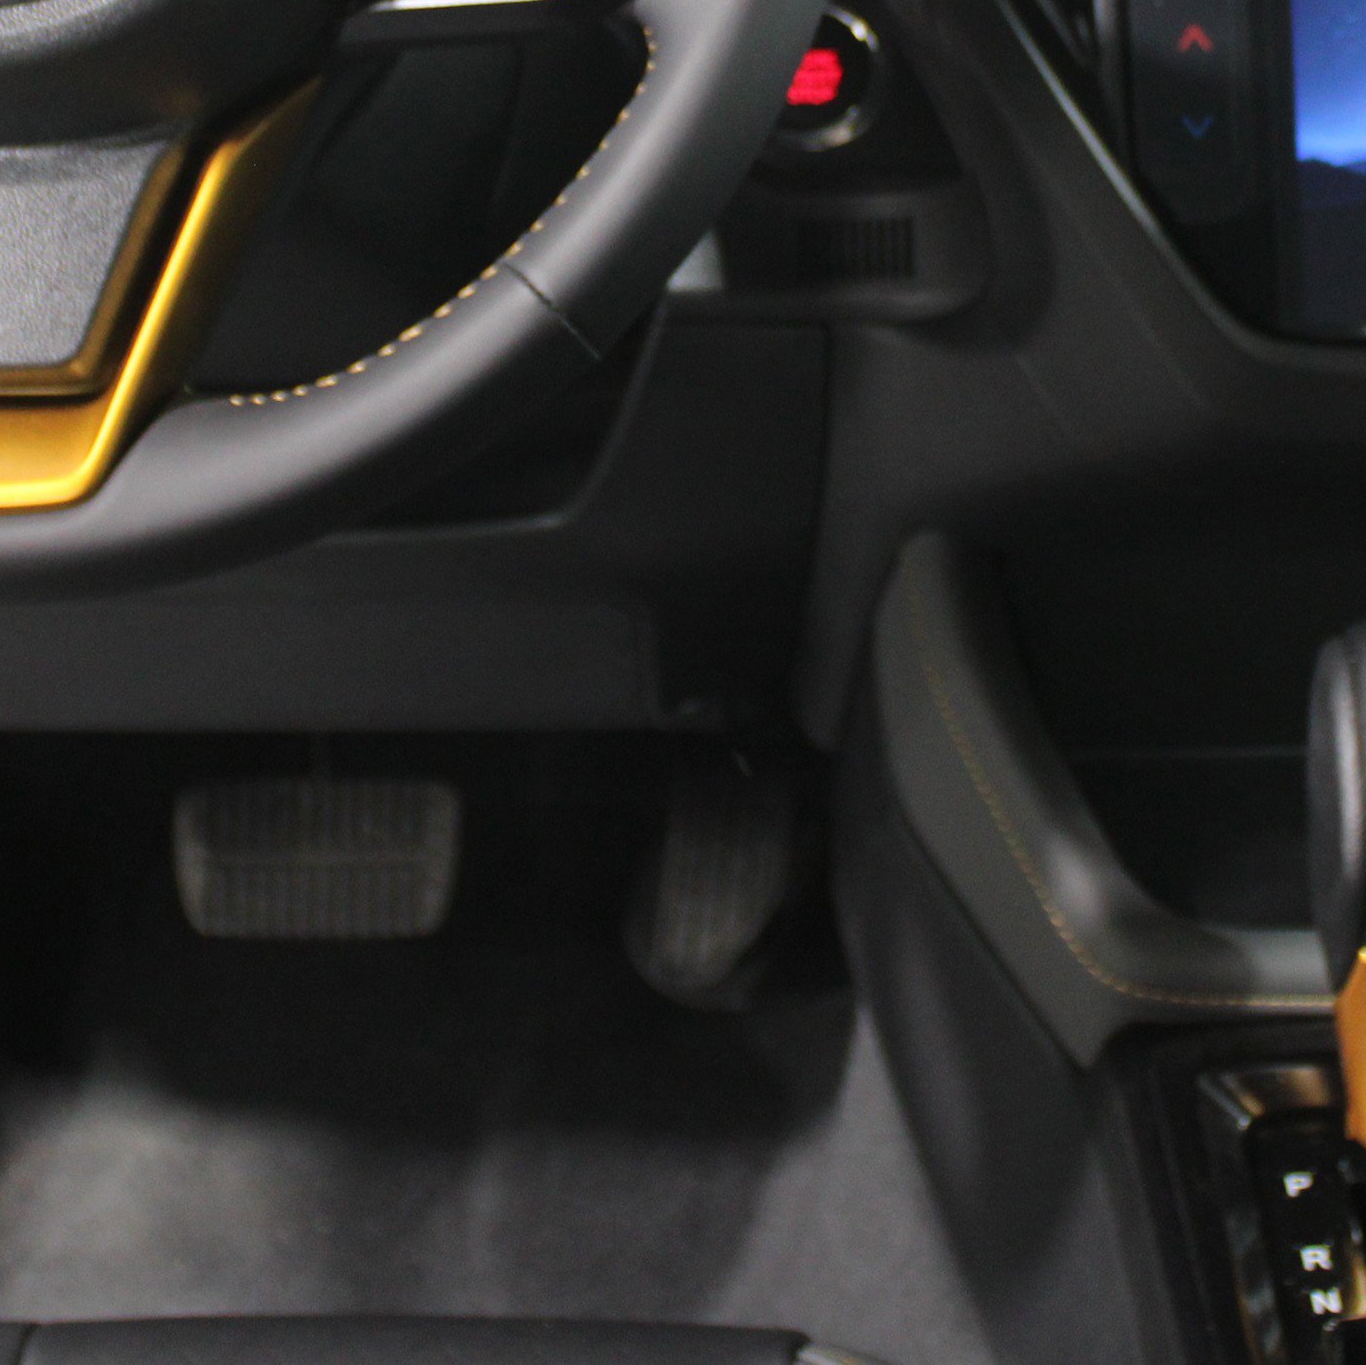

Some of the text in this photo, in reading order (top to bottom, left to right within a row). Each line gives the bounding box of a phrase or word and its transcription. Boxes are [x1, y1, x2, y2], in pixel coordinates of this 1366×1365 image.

[1283, 1171, 1314, 1198] P
[1301, 1244, 1333, 1272] R
[1309, 1286, 1343, 1315] N
